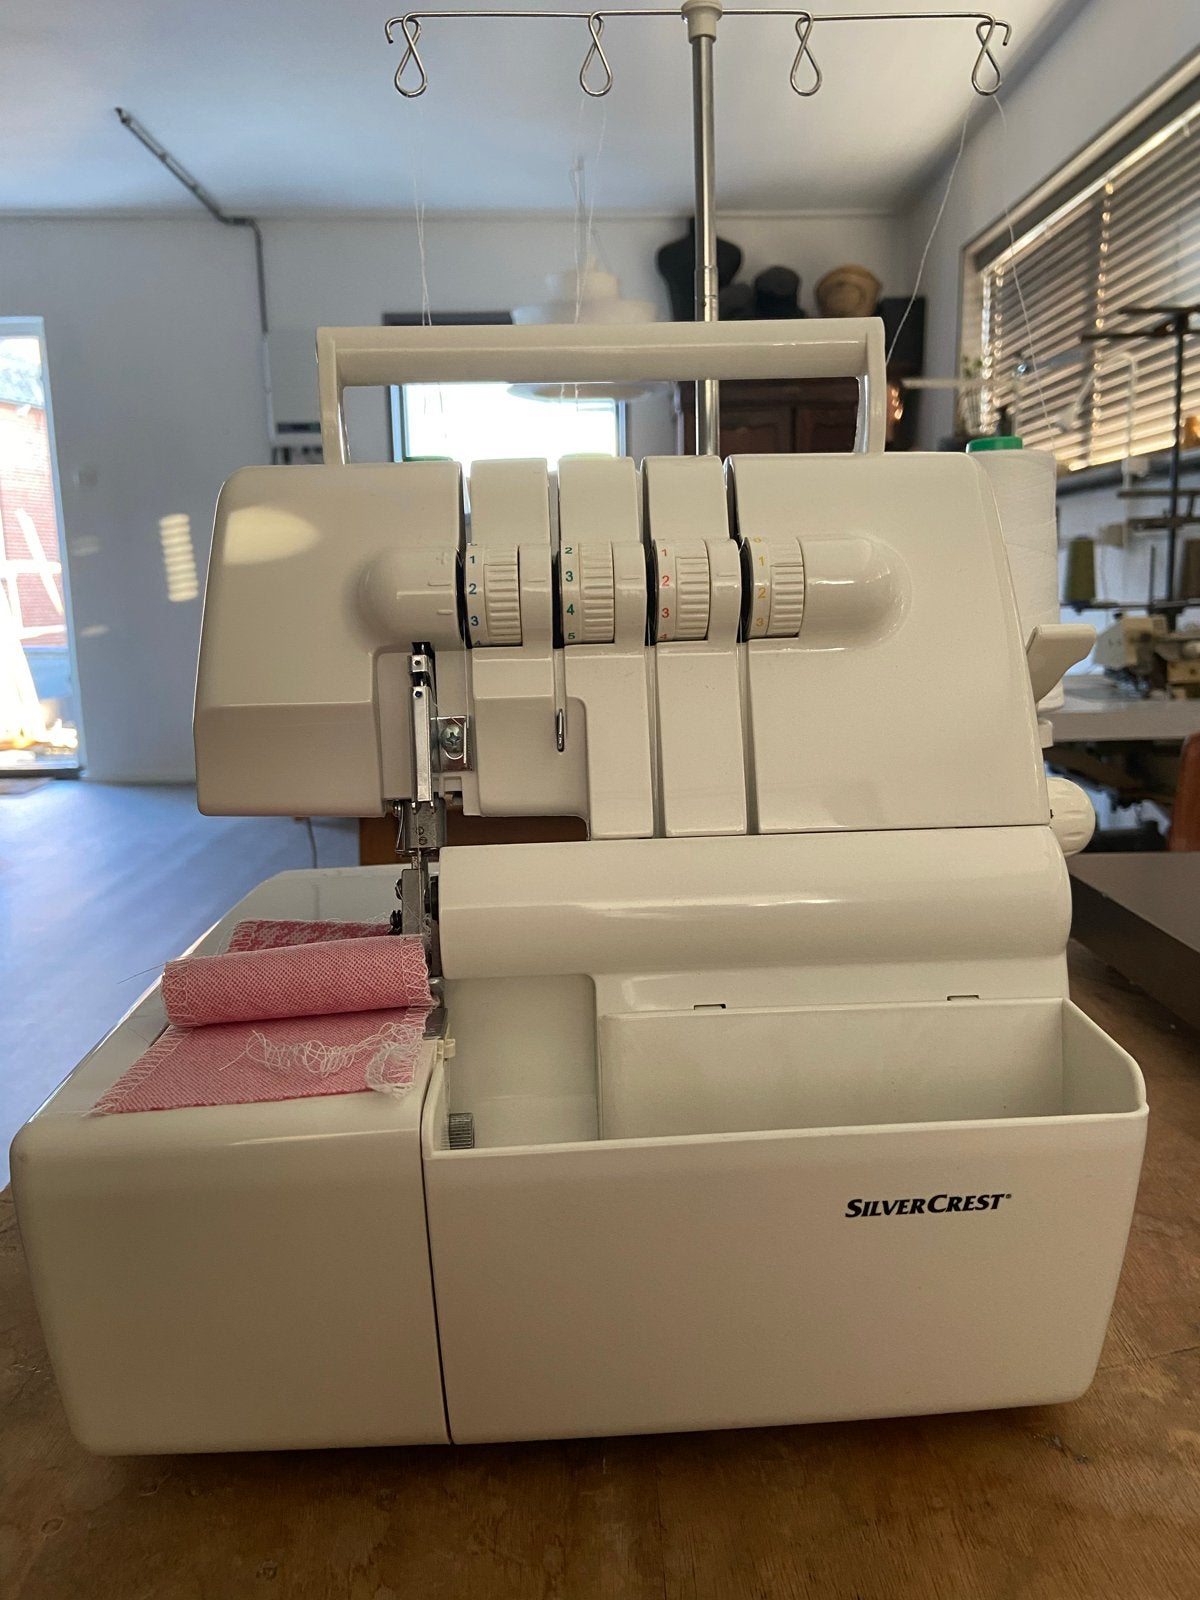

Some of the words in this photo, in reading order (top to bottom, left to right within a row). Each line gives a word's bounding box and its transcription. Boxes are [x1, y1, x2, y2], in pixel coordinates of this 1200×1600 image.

[469, 555, 475, 564] 1
[758, 556, 764, 566] 1
[565, 571, 573, 582] 3
[661, 575, 670, 586] 2
[468, 583, 477, 594] 2
[757, 587, 766, 598] 2
[566, 604, 574, 615] 4
[661, 608, 670, 619] 3
[470, 616, 479, 626] 3
[756, 617, 764, 627] 3
[567, 632, 576, 640] 5
